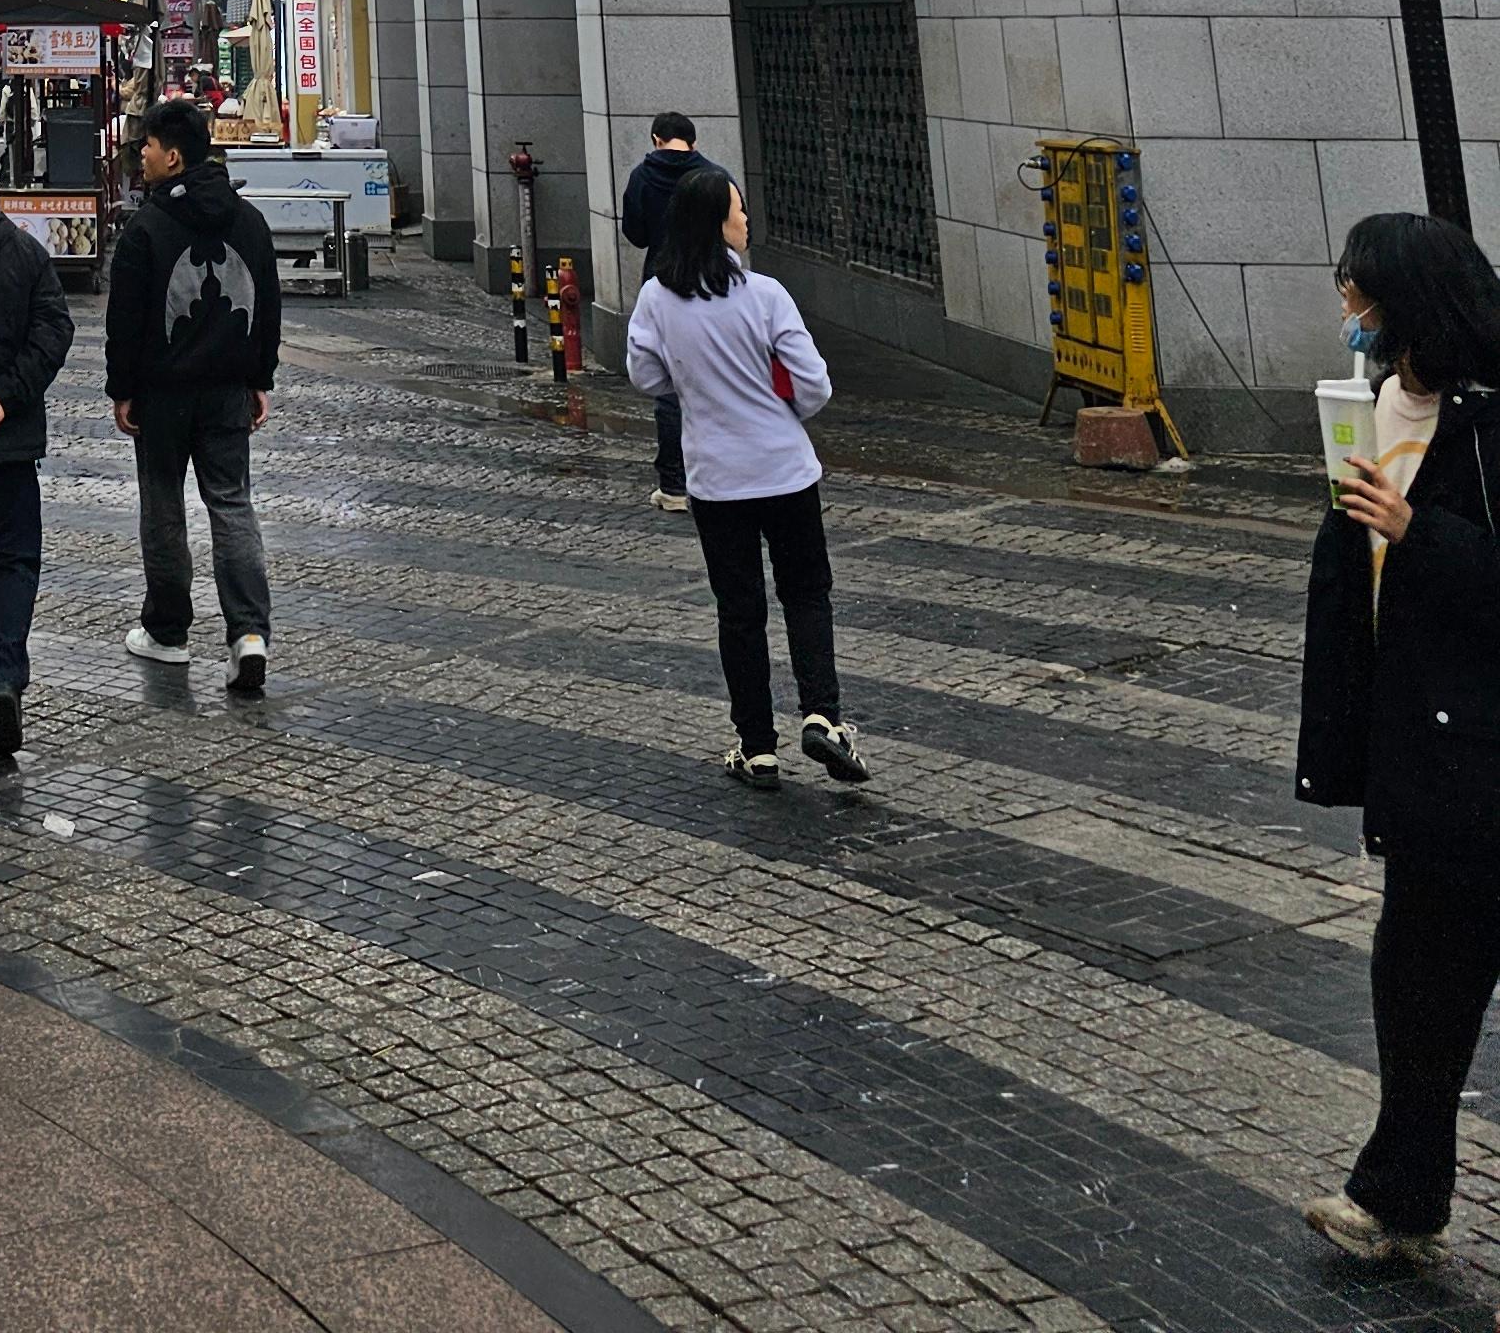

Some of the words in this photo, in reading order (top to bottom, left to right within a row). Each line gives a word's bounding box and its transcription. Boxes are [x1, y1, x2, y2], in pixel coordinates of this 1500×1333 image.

[49, 28, 99, 48] 雪绵豆沙
[298, 17, 317, 89] 全国包邮
